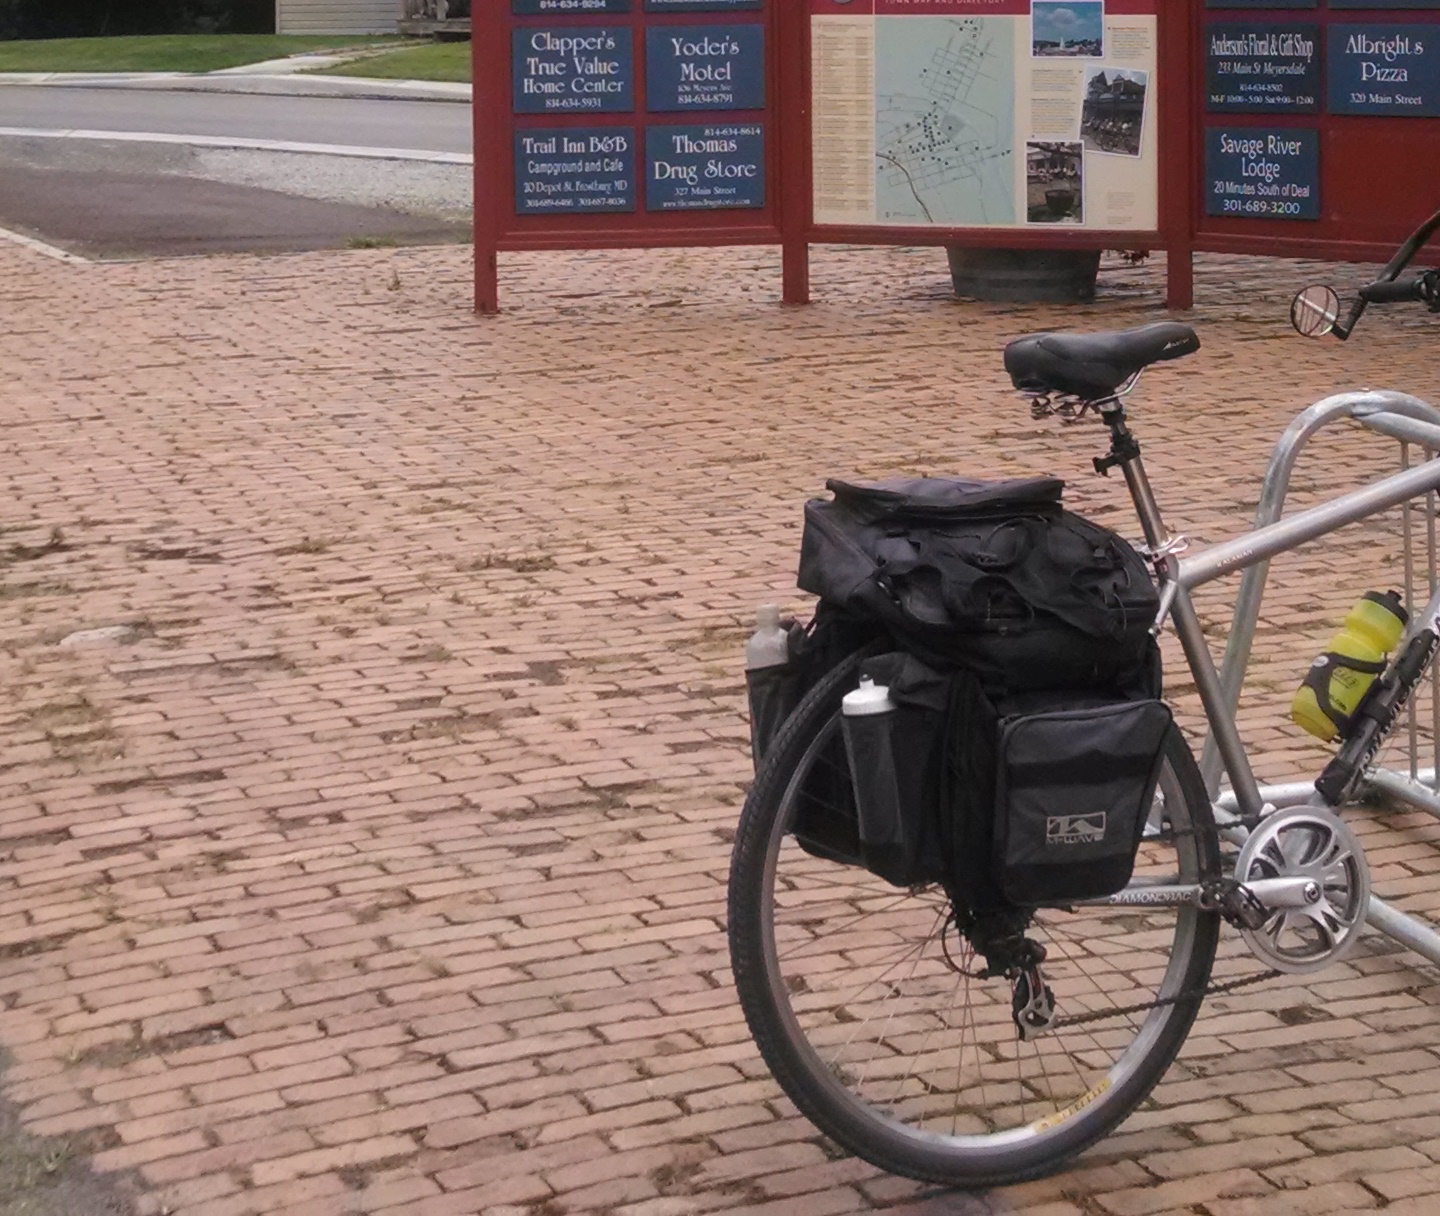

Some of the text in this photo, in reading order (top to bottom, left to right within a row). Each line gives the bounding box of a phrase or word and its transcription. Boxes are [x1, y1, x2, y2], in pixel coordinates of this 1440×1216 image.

[531, 31, 615, 56] Clapper's
[671, 35, 739, 56] Yoder's
[1211, 33, 1313, 63] Anderson's Floral & Gift Shop
[527, 56, 619, 75] True Value
[680, 61, 731, 81] Motel
[1232, 62, 1251, 74] Main
[1253, 62, 1261, 74] St
[1263, 62, 1305, 77] Meyersdale
[1361, 62, 1408, 81] Pizza
[524, 77, 624, 93] Home Center
[1351, 93, 1422, 104] 320 Main Street
[523, 136, 627, 154] Trail Inn B&B
[673, 135, 737, 153] Thomas
[1221, 133, 1301, 159] Savage River
[528, 158, 623, 175] Campground and Cafe
[654, 160, 756, 185] Drug Store
[1242, 157, 1280, 182] Lodge
[536, 182, 561, 195] Depot
[576, 180, 612, 194] Frostburg
[614, 180, 627, 191] MD
[691, 186, 735, 195] Main Street
[1214, 181, 1309, 197] 20 Minutes South of Deal
[1224, 199, 1299, 213] 301-689-3200
